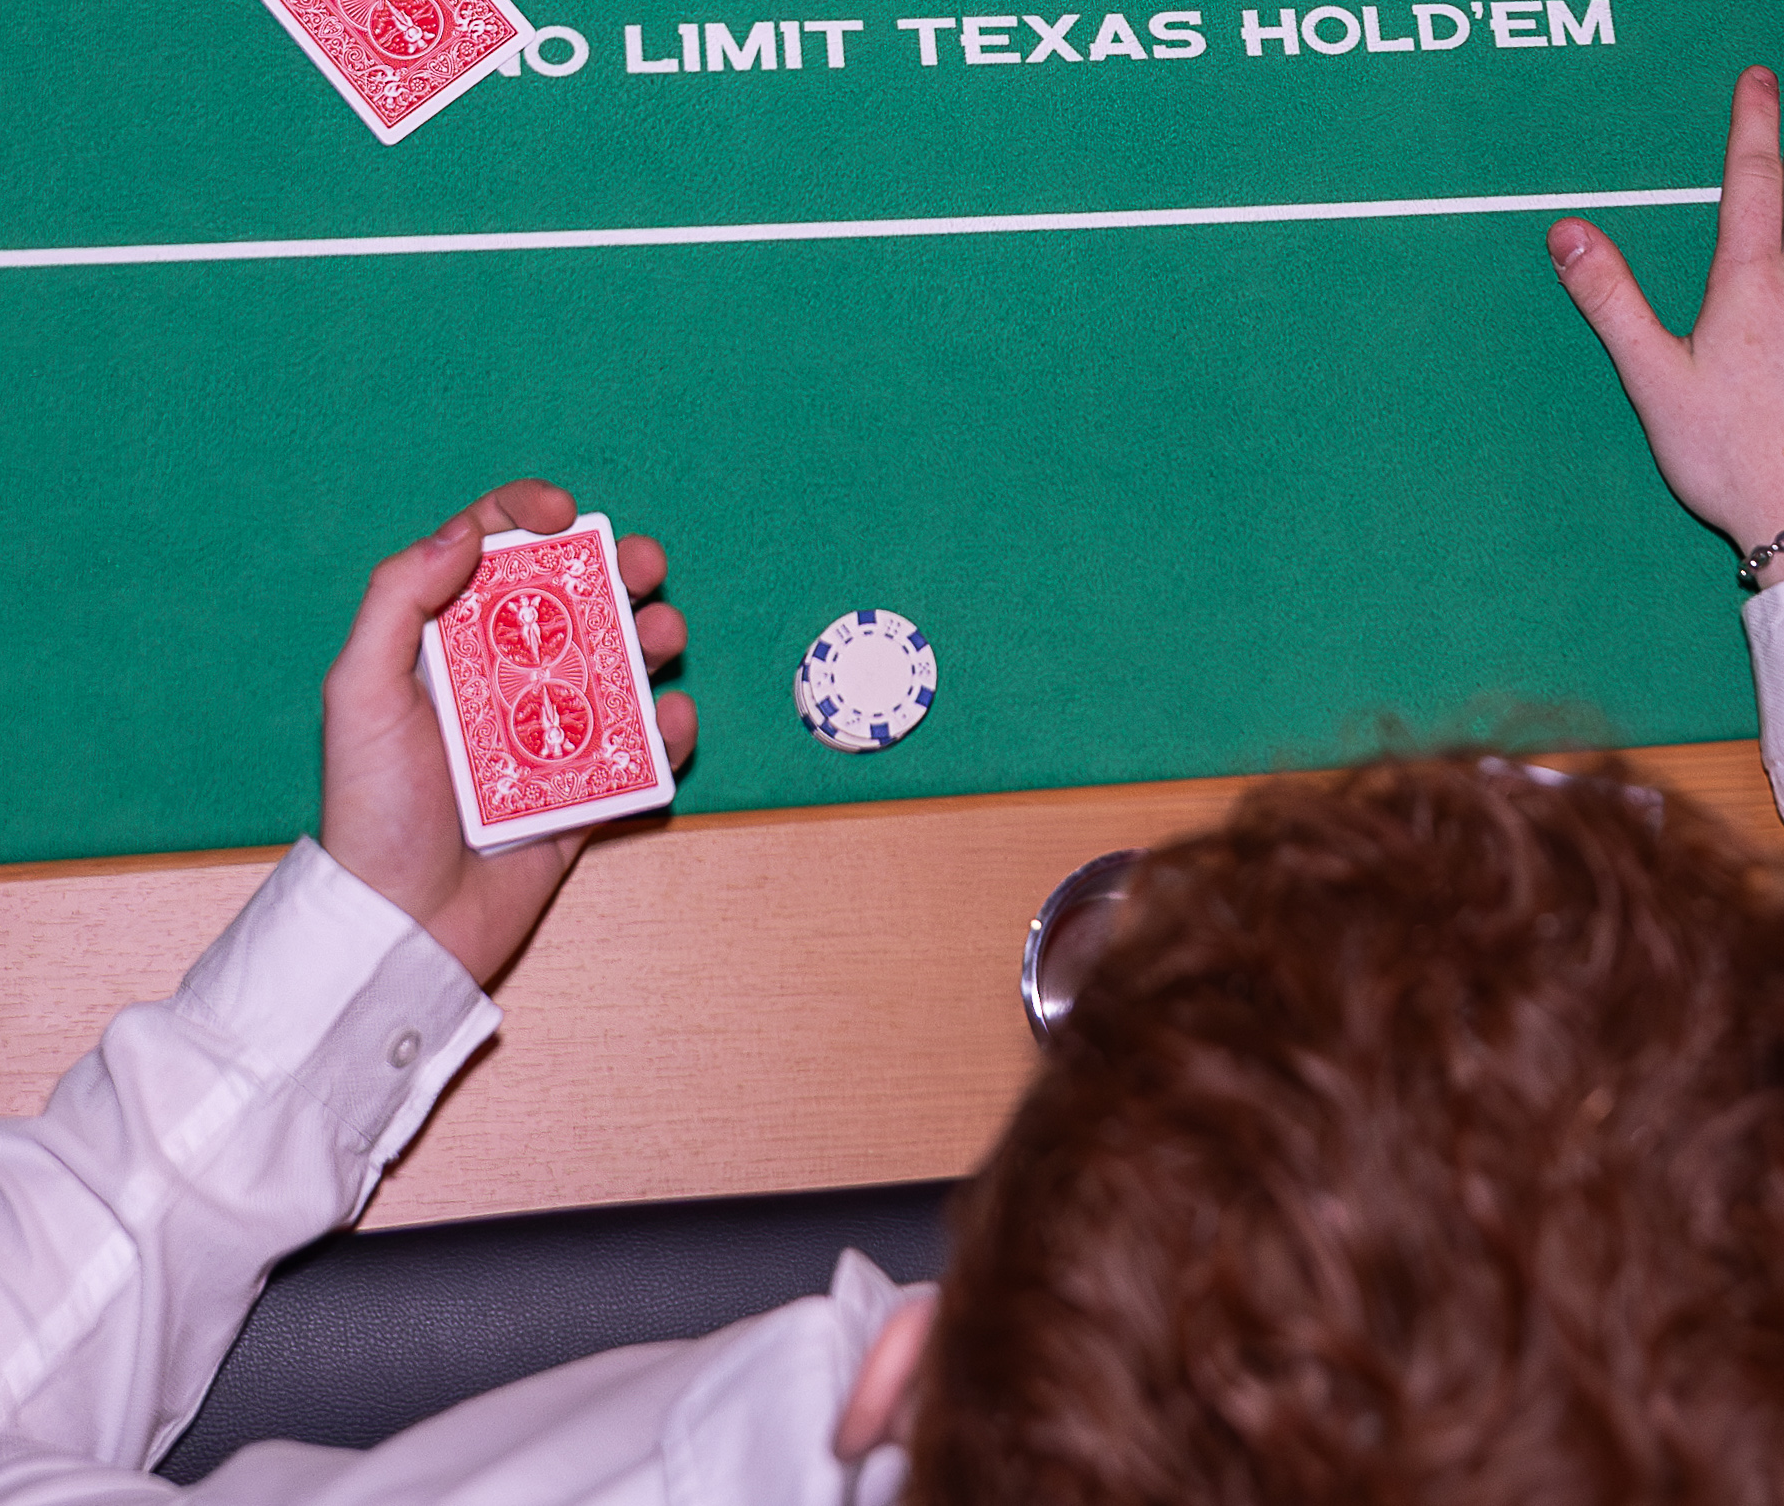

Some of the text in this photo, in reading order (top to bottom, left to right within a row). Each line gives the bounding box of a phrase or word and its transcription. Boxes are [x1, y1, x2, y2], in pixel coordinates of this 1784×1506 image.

[497, 24, 590, 77] O
[624, 19, 864, 74] LIMIT
[896, 10, 1207, 67] TEXAS
